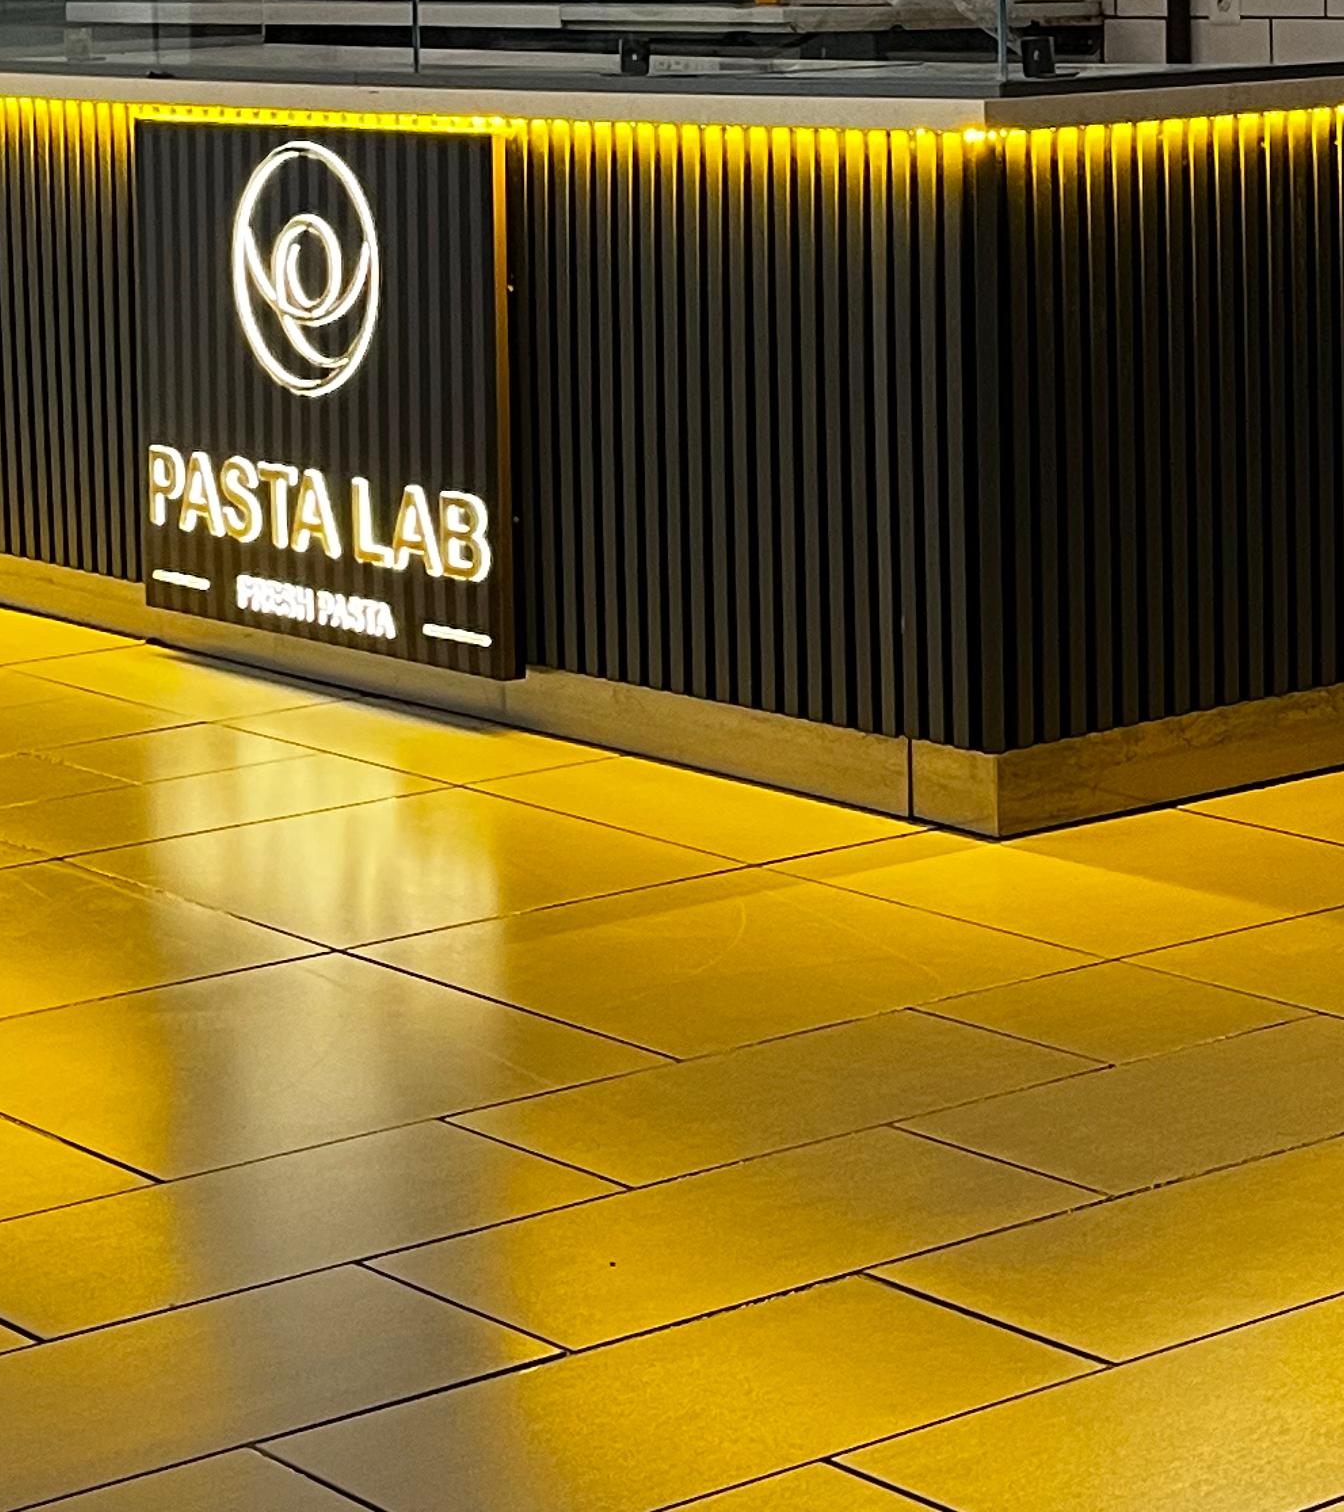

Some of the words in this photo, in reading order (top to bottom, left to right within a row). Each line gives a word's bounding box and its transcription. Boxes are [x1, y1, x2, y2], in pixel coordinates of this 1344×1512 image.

[149, 444, 342, 560] PASTA
[351, 476, 492, 583] LAB
[236, 574, 316, 622] FRESH
[317, 590, 396, 639] PASTA
